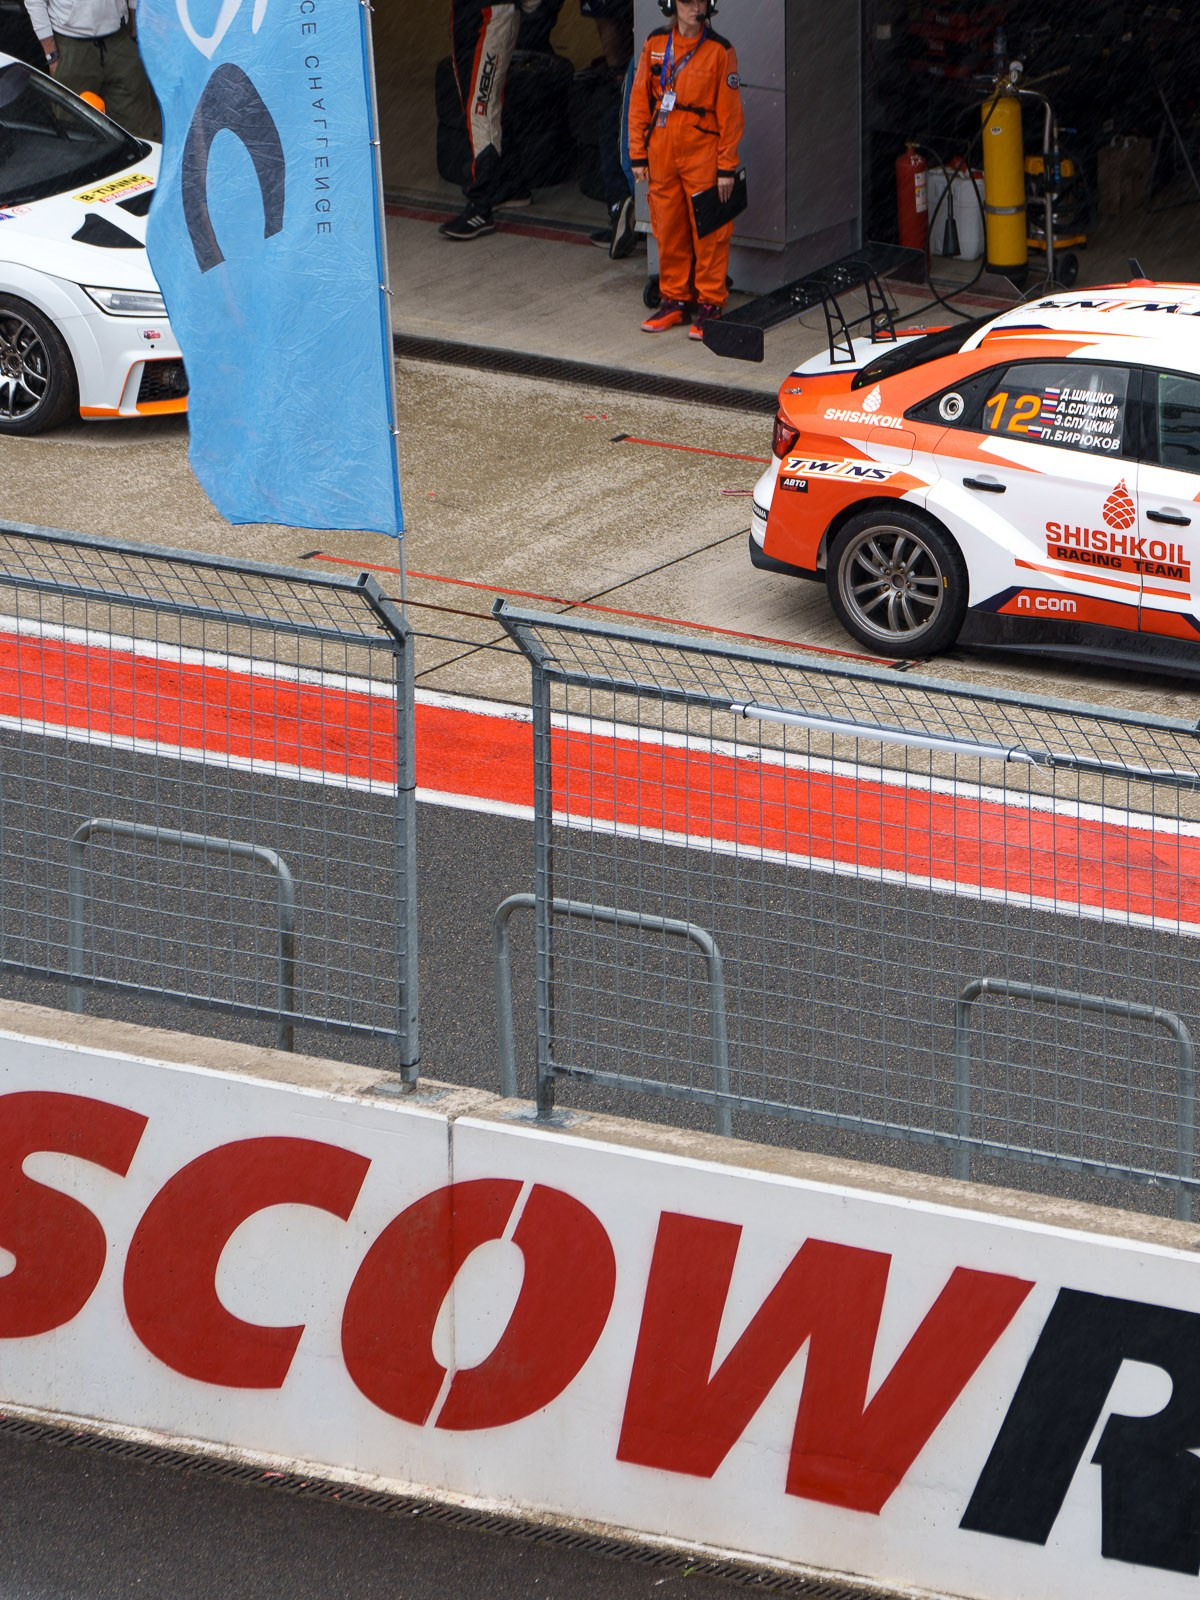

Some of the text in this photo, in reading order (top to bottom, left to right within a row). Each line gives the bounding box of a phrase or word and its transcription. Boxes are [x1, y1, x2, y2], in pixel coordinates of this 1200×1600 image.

[1059, 388, 1115, 405] Д.ШИШКО
[823, 408, 904, 429] SHISHKOIL
[986, 391, 1042, 433] 12
[1056, 402, 1119, 420] А.СЛУЦКИЙ
[1054, 414, 1115, 434] З.СЛУЦКИЙ
[1041, 428, 1121, 450] П.БИРЮКОВ
[788, 458, 893, 480] TWINS
[1046, 521, 1191, 566] SHISHKOIL
[1057, 547, 1183, 578] RACING TEAM
